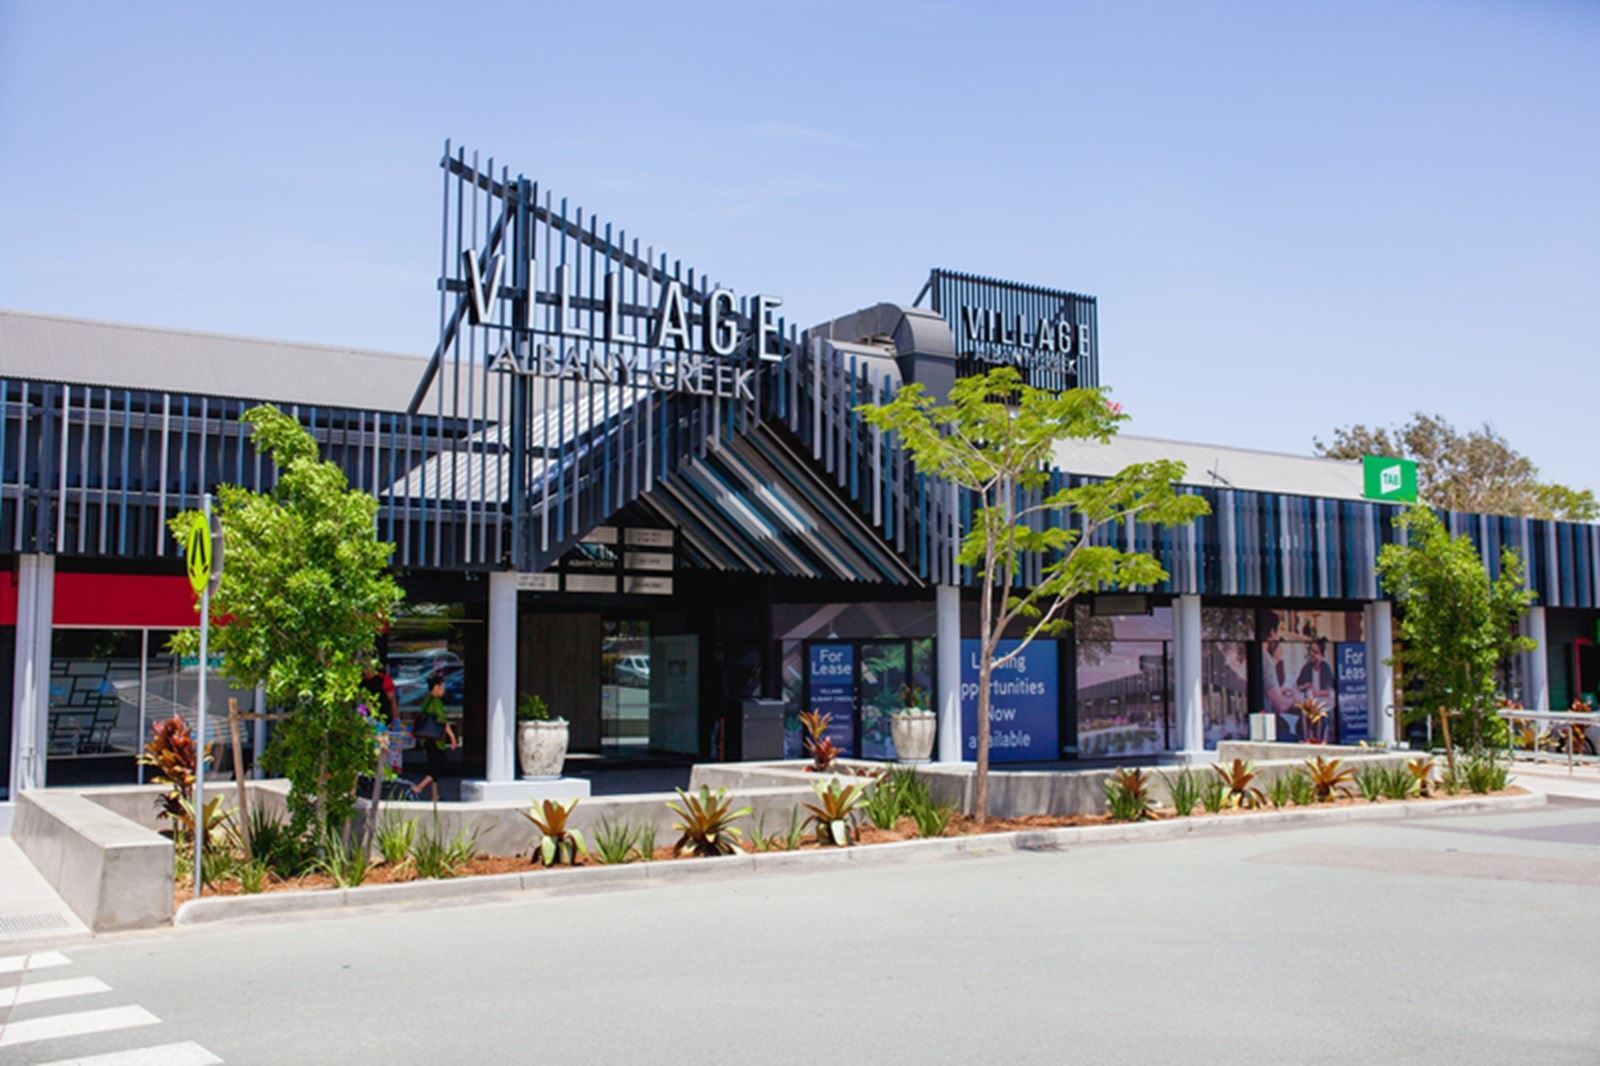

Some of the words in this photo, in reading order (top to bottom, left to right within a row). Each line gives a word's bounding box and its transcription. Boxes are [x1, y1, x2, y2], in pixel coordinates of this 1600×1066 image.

[461, 248, 784, 363] VILLAGE
[962, 305, 1090, 356] VILLAGE
[488, 336, 637, 386] ALBANY
[650, 354, 756, 400] CREEK
[819, 648, 844, 663] For
[1344, 647, 1365, 665] For
[811, 661, 853, 676] Lease
[1338, 662, 1367, 681] Leas
